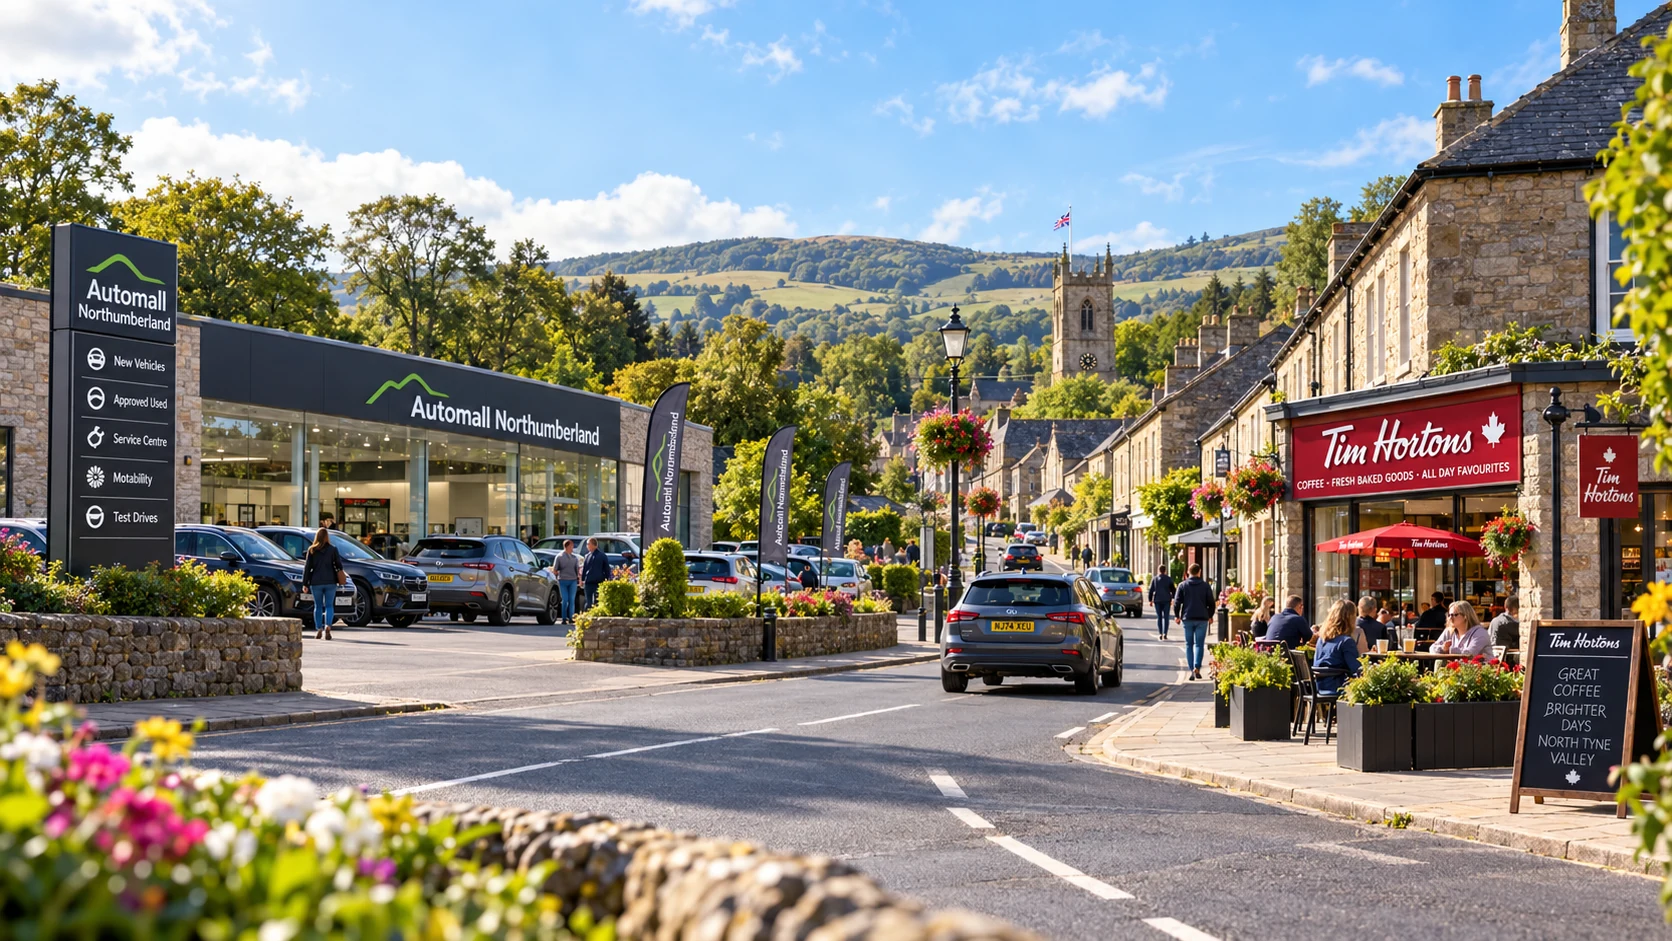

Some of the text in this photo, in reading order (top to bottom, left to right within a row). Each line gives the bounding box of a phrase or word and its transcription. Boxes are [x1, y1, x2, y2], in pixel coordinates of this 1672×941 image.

[86, 279, 167, 312] Automall
[78, 303, 171, 331] Northumberland
[114, 356, 166, 372] New Vehicles
[113, 394, 168, 410] Approved Used
[411, 395, 600, 446] Automall Northumberland
[113, 433, 168, 447] Service Centre
[1321, 418, 1472, 469] Tim Hortons
[113, 472, 153, 486] Motability
[1297, 461, 1510, 490] COFFEE FRESH BAKED GOODS ALL DAY FAVOURITES
[1595, 466, 1621, 485] Tim
[1583, 482, 1634, 503] Hortons
[113, 511, 159, 524] Test Drives
[1549, 632, 1620, 649] Tim Hortons
[1557, 667, 1600, 681] GREAT
[1553, 684, 1601, 698] COFFEE
[1543, 702, 1607, 719] BRIGHTER
[1561, 719, 1592, 732] DAYS
[1537, 734, 1611, 751] NORTH TYNE
[1550, 752, 1595, 766] VALLEY
